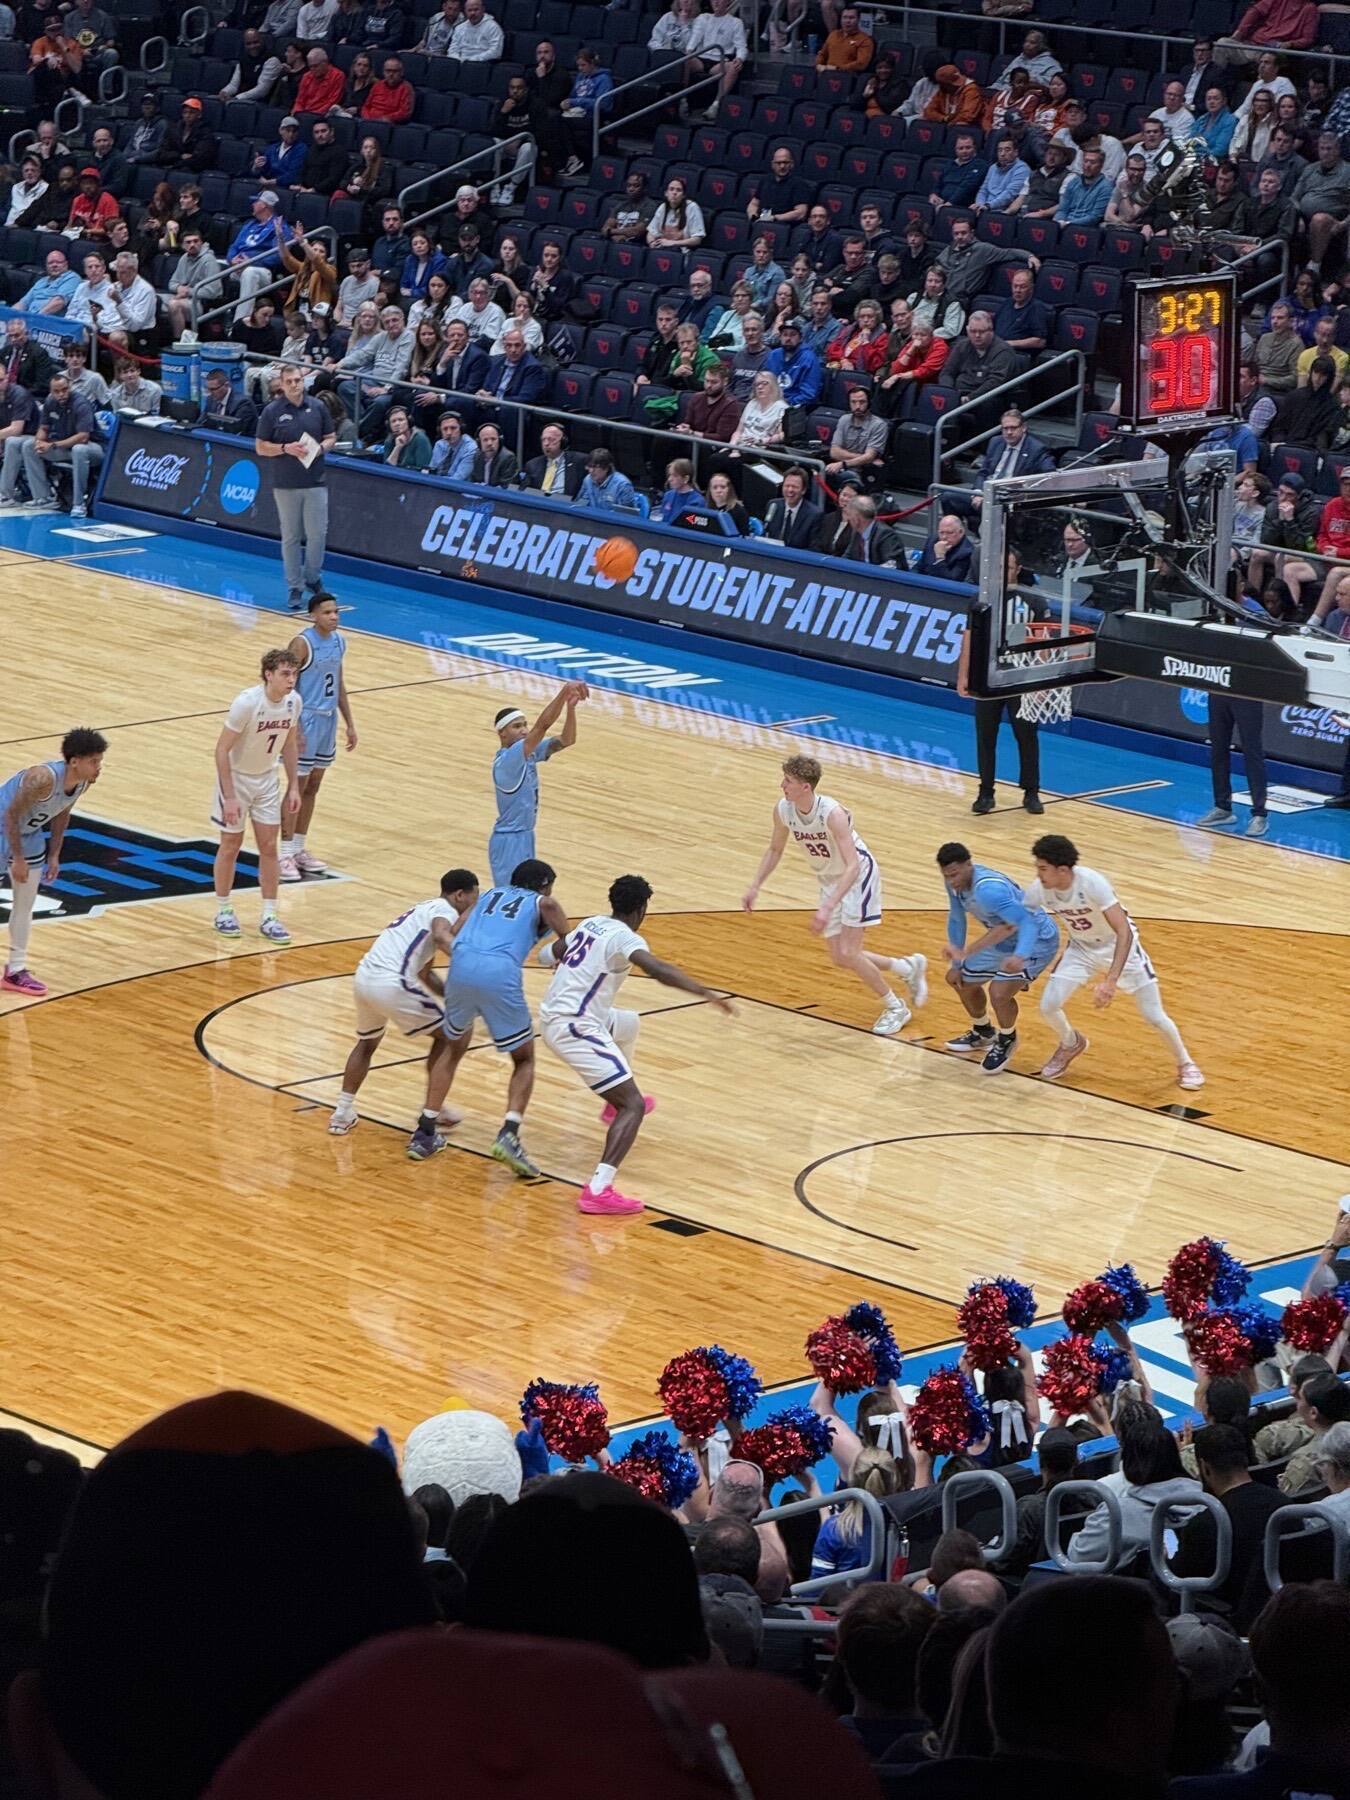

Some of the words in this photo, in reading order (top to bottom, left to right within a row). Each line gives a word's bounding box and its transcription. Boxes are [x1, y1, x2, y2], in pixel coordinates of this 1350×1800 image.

[1158, 291, 1221, 334] 3:27
[1150, 335, 1212, 410] 30
[1157, 411, 1207, 424] DAKTRONICS
[124, 448, 191, 486] Coca-Cola
[223, 484, 257, 503] NCAA
[421, 505, 629, 590] CELEBRATE
[625, 548, 968, 665] STUDENT-ATHLETES
[447, 632, 724, 689] DAYTON
[1161, 655, 1232, 688] SPALDING
[325, 673, 335, 698] 2
[256, 718, 292, 733] EAGLES
[1291, 726, 1314, 737] ZERO
[1315, 731, 1344, 744] SUGAR
[267, 734, 279, 754] 7
[793, 830, 828, 841] EAGLES
[482, 891, 526, 919] 14
